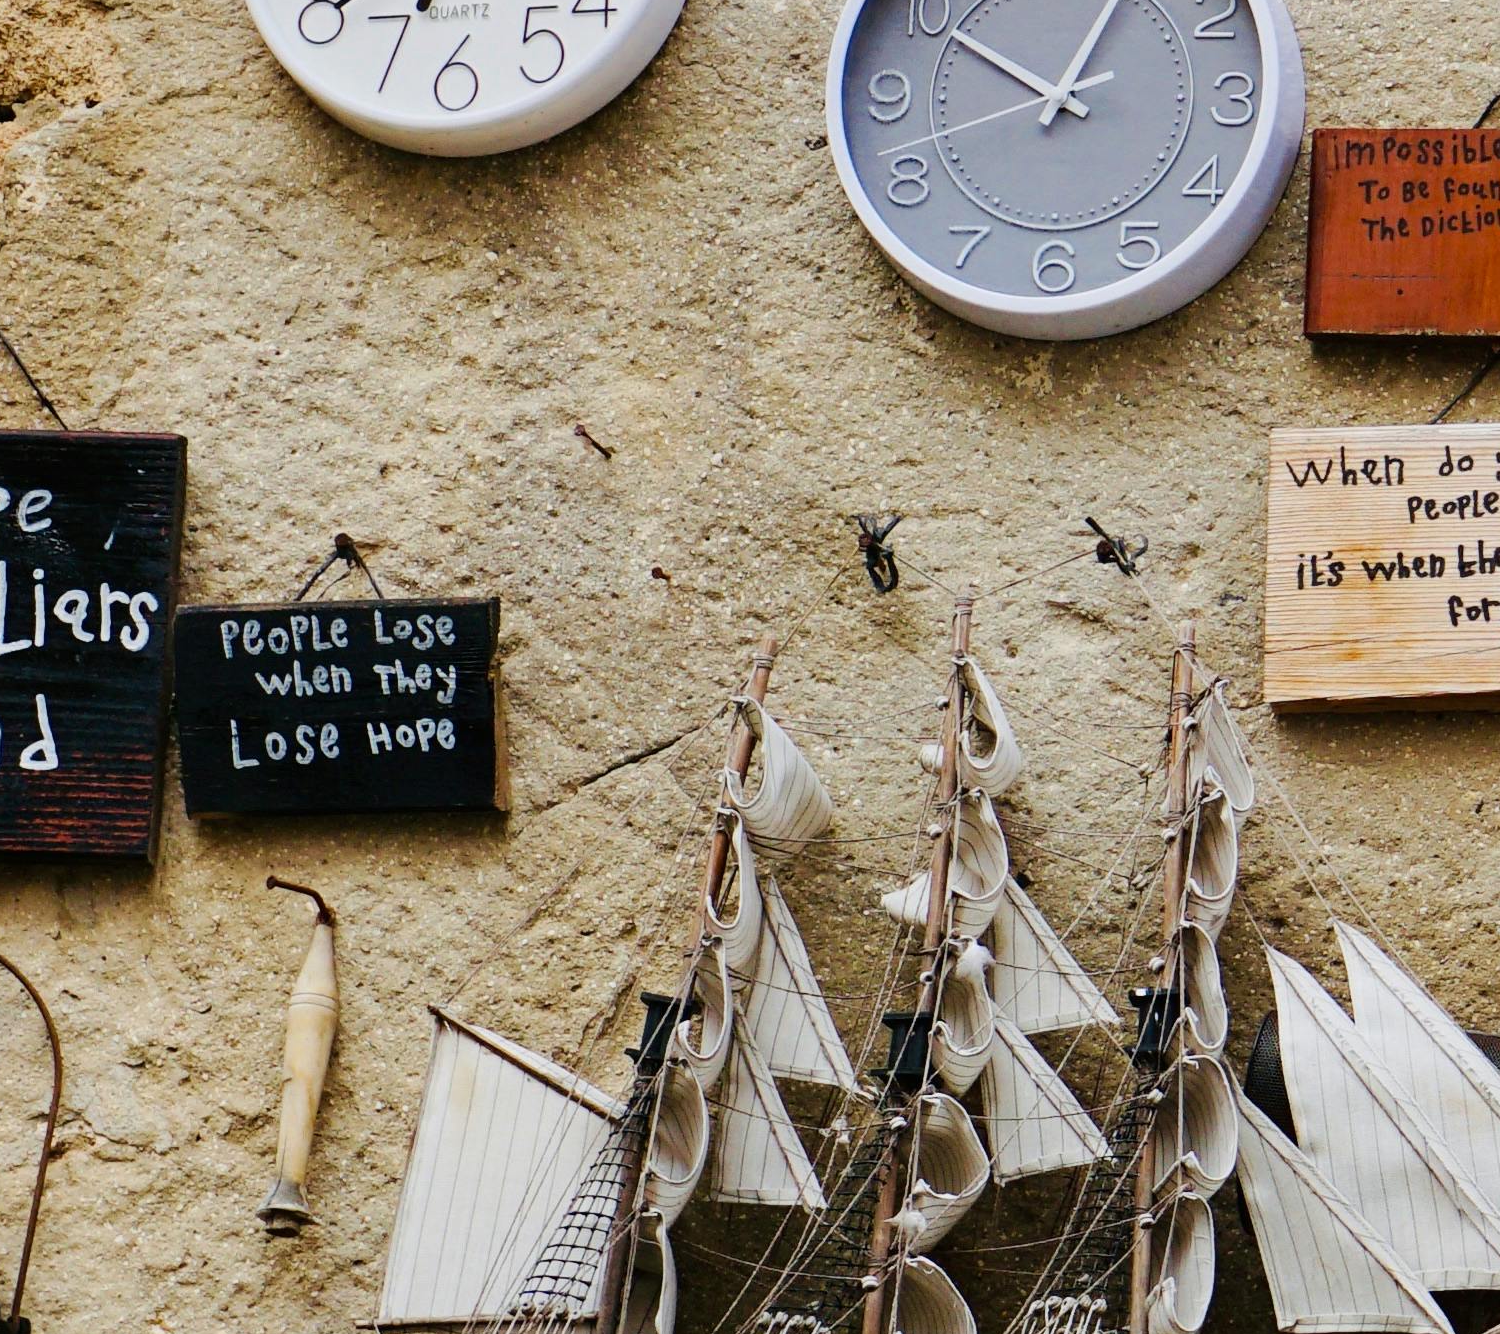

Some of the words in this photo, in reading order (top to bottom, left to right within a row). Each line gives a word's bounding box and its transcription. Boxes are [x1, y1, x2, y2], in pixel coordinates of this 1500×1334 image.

[429, 3, 491, 19] QUARTZ
[1362, 217, 1409, 241] The
[1439, 445, 1473, 476] do
[1363, 550, 1444, 581] when
[256, 663, 351, 697] when
